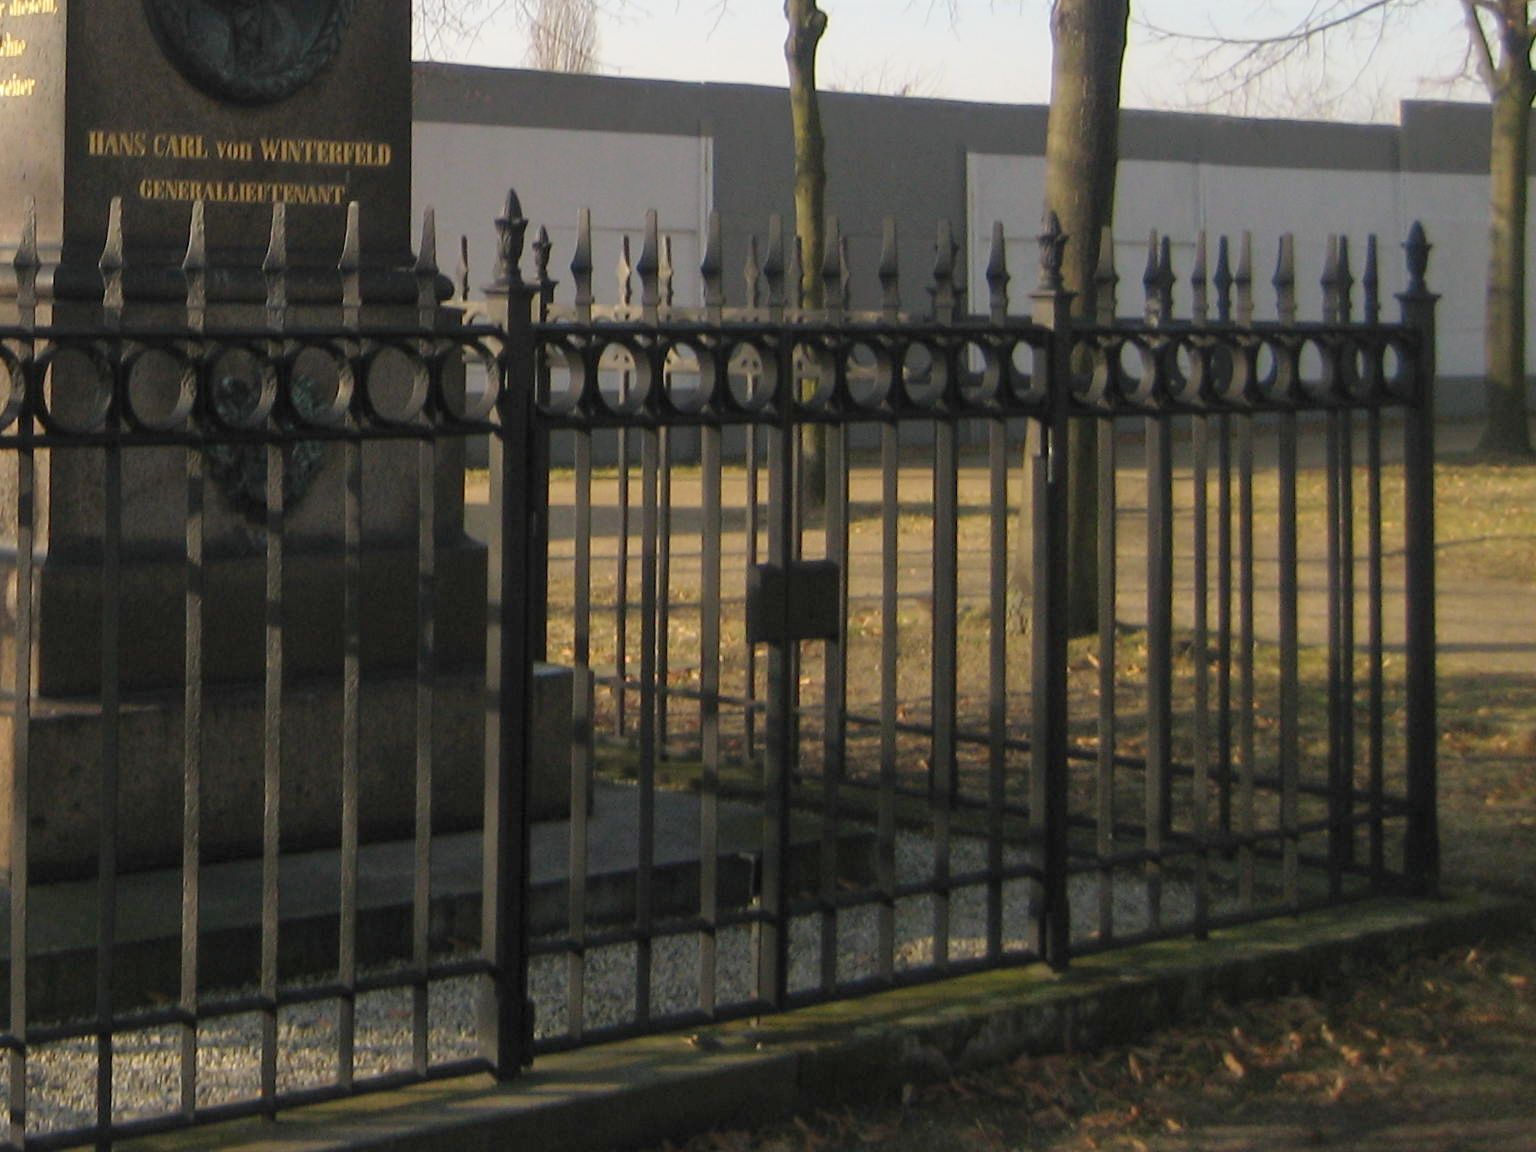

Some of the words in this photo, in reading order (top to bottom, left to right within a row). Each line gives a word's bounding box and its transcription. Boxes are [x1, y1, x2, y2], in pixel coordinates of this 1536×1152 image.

[88, 130, 146, 157] HANS
[153, 132, 208, 159] CARL
[216, 141, 253, 162] von
[260, 138, 392, 166] WINTERFELD
[138, 178, 345, 205] GENERALLIEUTENANT
